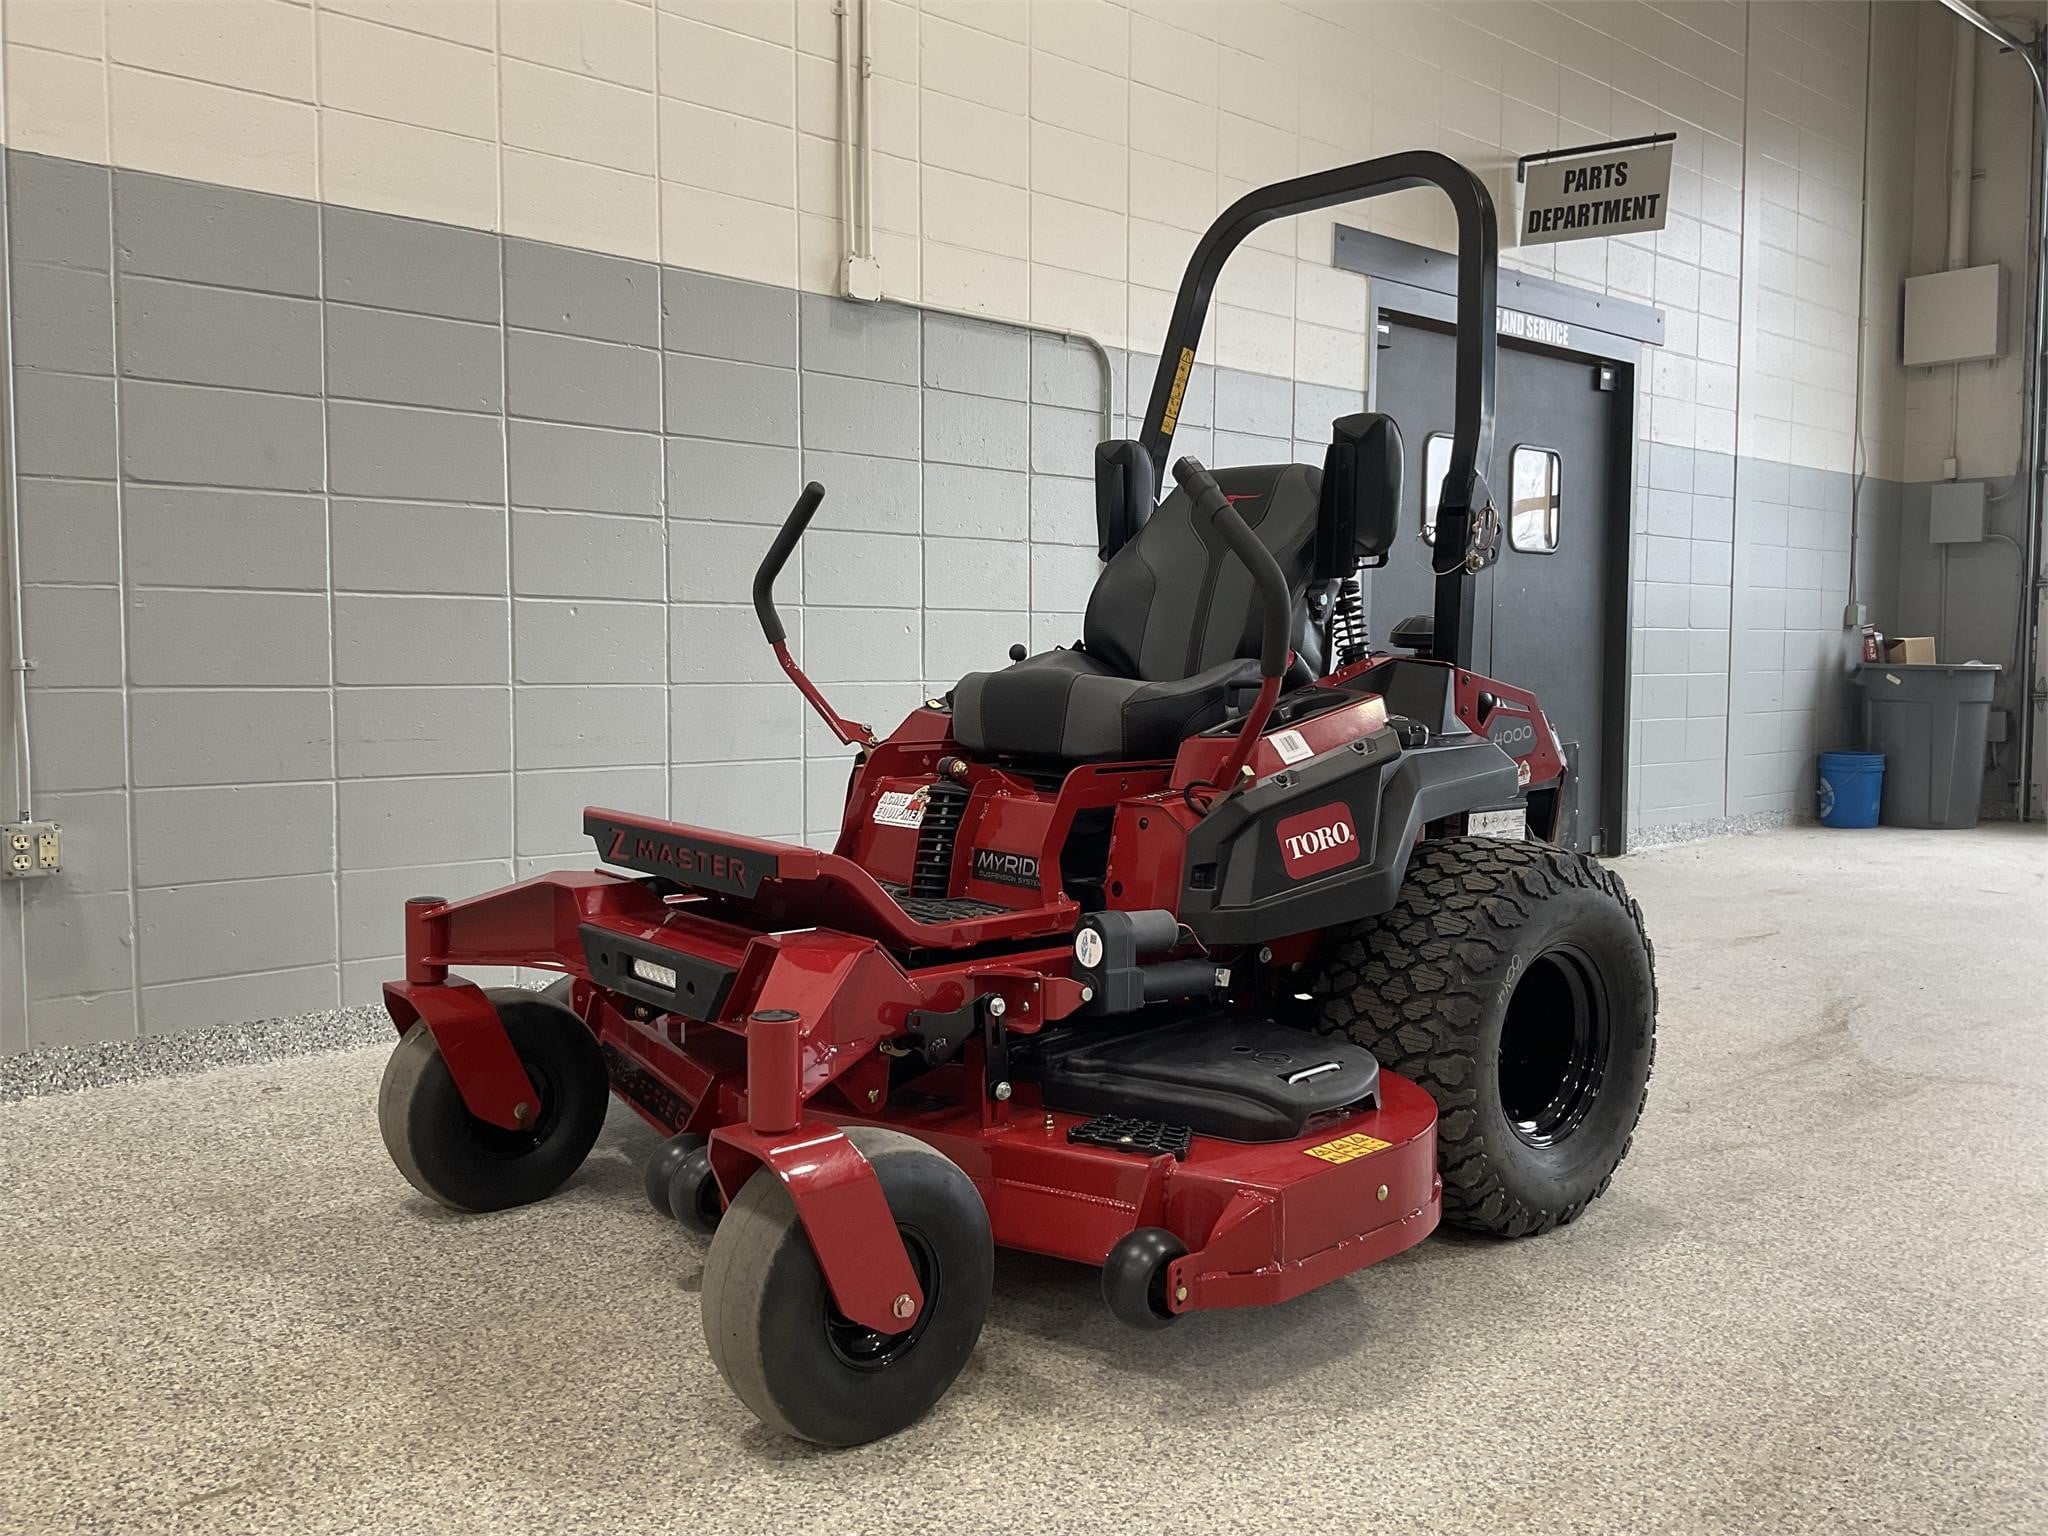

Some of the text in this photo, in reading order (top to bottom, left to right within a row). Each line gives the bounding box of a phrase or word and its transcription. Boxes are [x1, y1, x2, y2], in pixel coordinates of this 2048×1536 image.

[1563, 161, 1628, 194] PARTS
[1528, 194, 1660, 234] DEPARTMENT
[1502, 310, 1524, 336] AND
[1526, 316, 1569, 346] SERVICE
[1494, 725, 1532, 746] 4000
[875, 806, 922, 823] EQUIPMEN
[880, 793, 909, 807] ACME
[608, 827, 748, 890] Z MASTER
